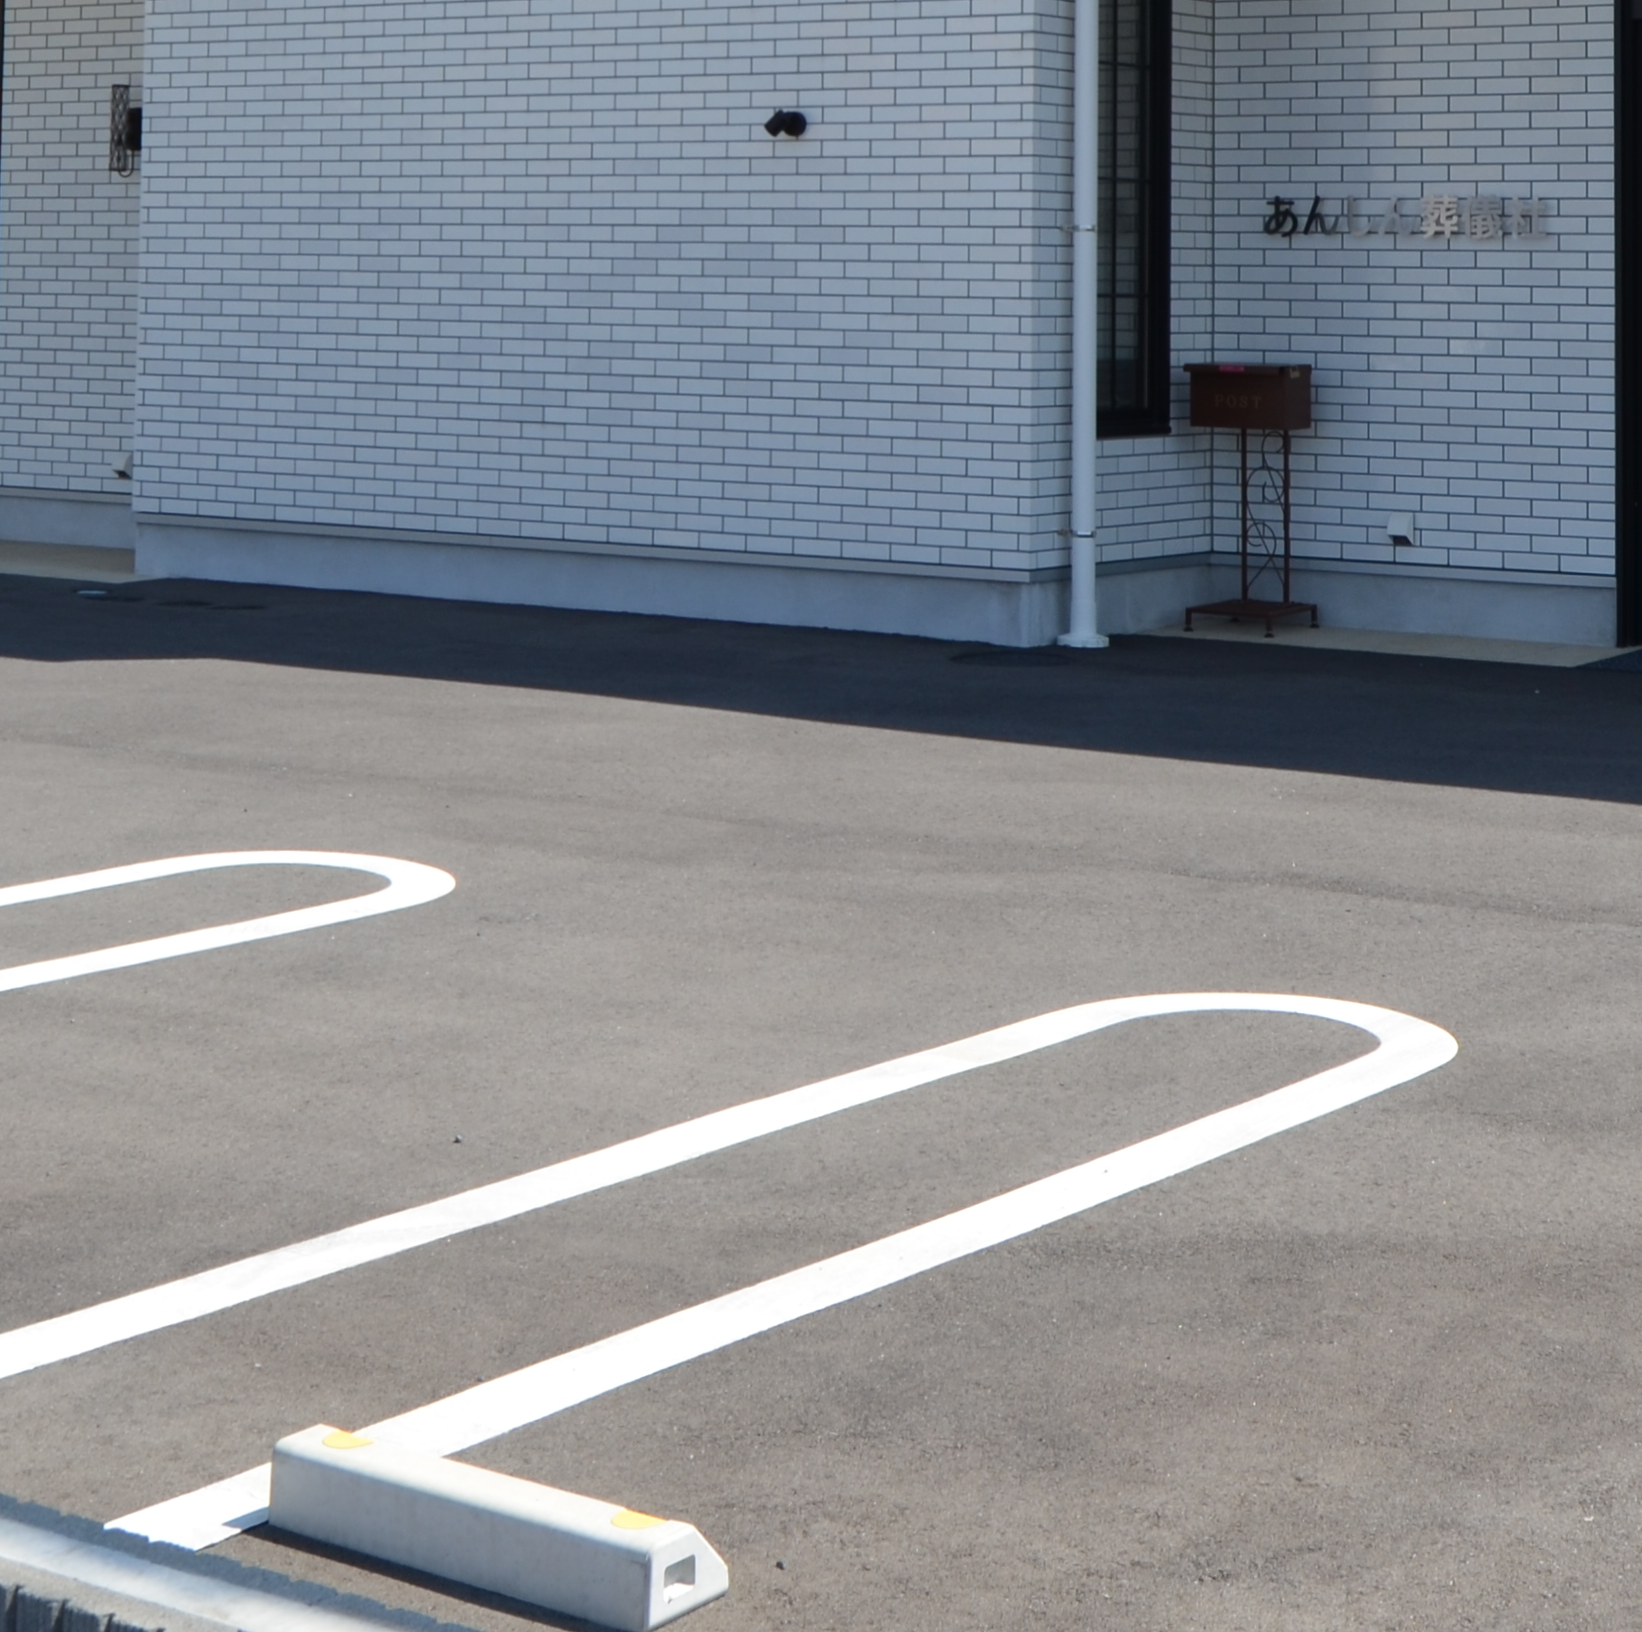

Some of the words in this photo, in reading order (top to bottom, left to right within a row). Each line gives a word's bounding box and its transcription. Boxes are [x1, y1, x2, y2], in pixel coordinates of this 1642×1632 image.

[1263, 194, 1548, 240] あんしん葬儀社
[1214, 394, 1262, 409] POST
